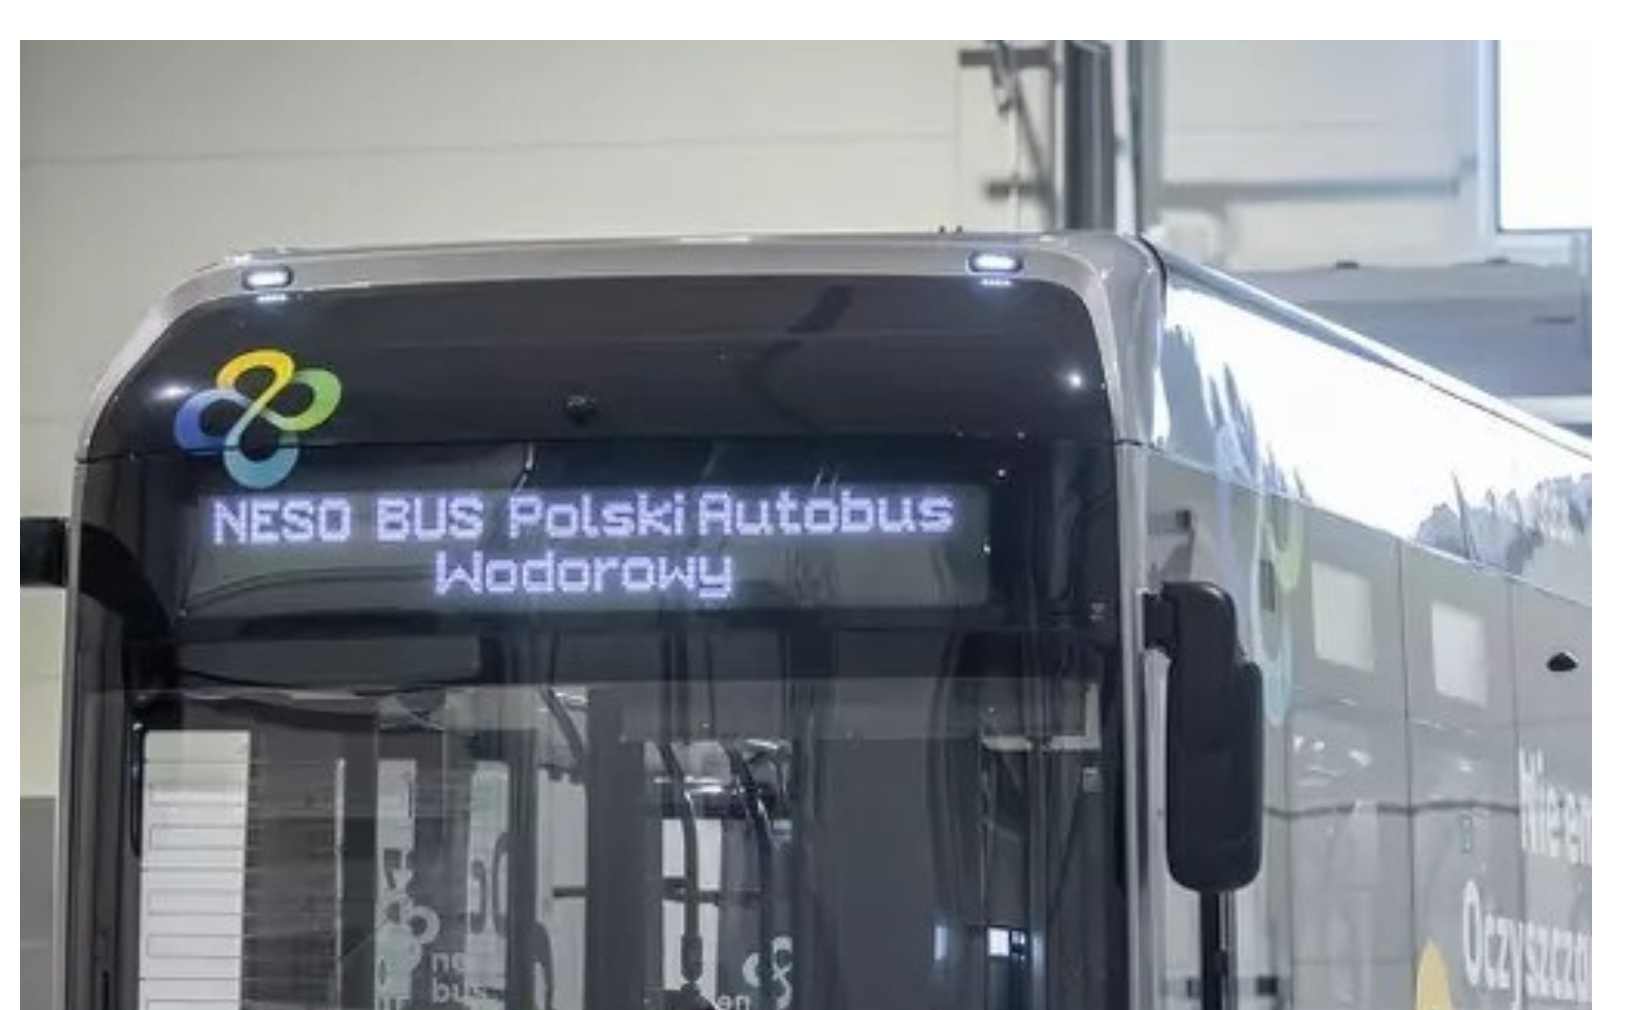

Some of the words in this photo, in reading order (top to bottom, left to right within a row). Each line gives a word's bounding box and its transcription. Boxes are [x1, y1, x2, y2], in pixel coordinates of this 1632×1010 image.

[213, 497, 351, 545] NESO
[377, 496, 484, 542] BUS
[509, 490, 684, 538] Polski
[698, 489, 954, 536] Autobus
[435, 549, 732, 600] Wodorowy
